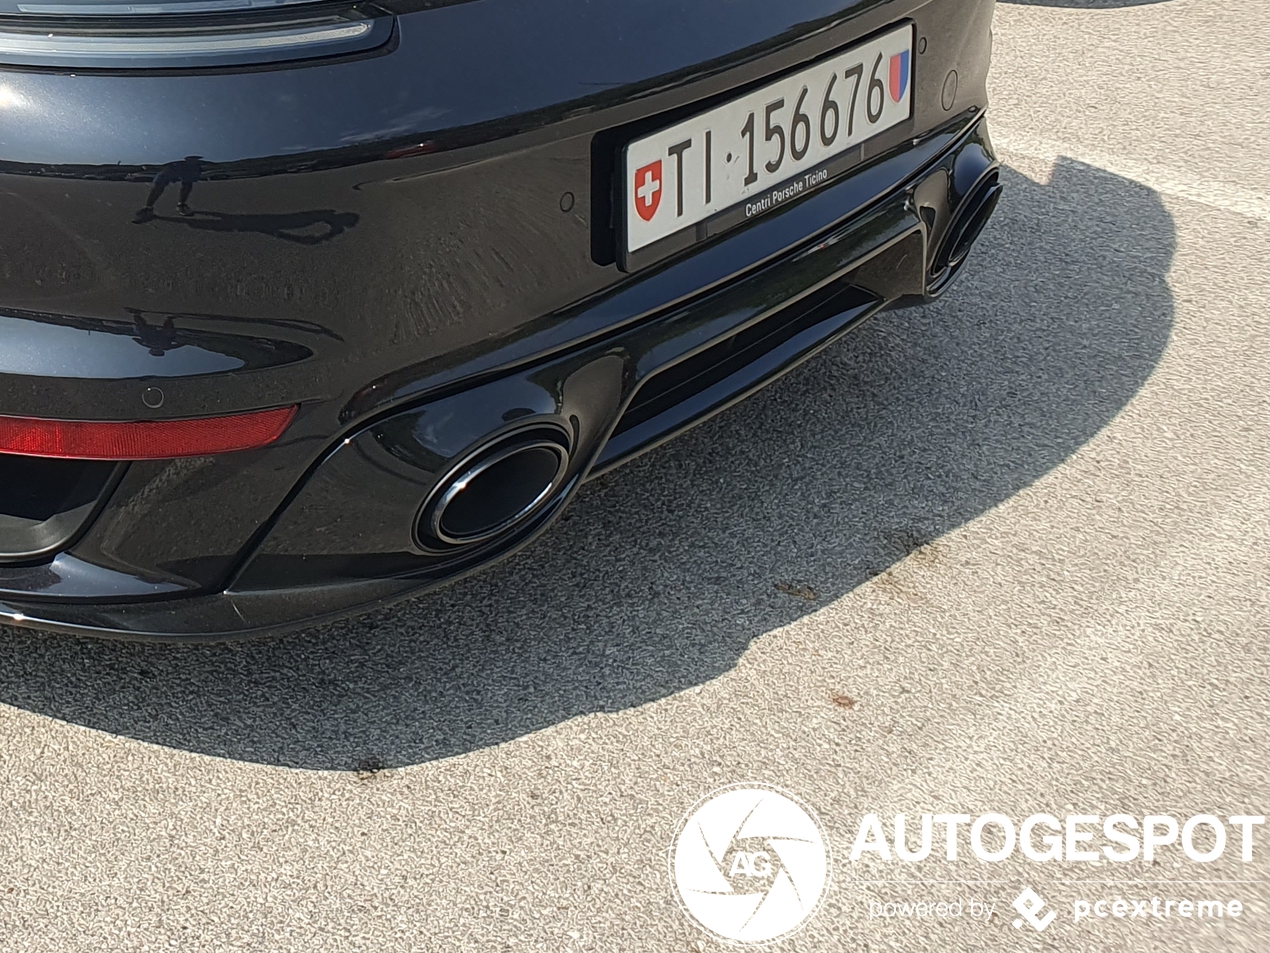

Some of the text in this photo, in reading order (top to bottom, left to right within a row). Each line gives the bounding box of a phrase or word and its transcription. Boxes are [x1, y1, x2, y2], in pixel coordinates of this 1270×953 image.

[745, 169, 828, 217] Centri Porsche Ticino
